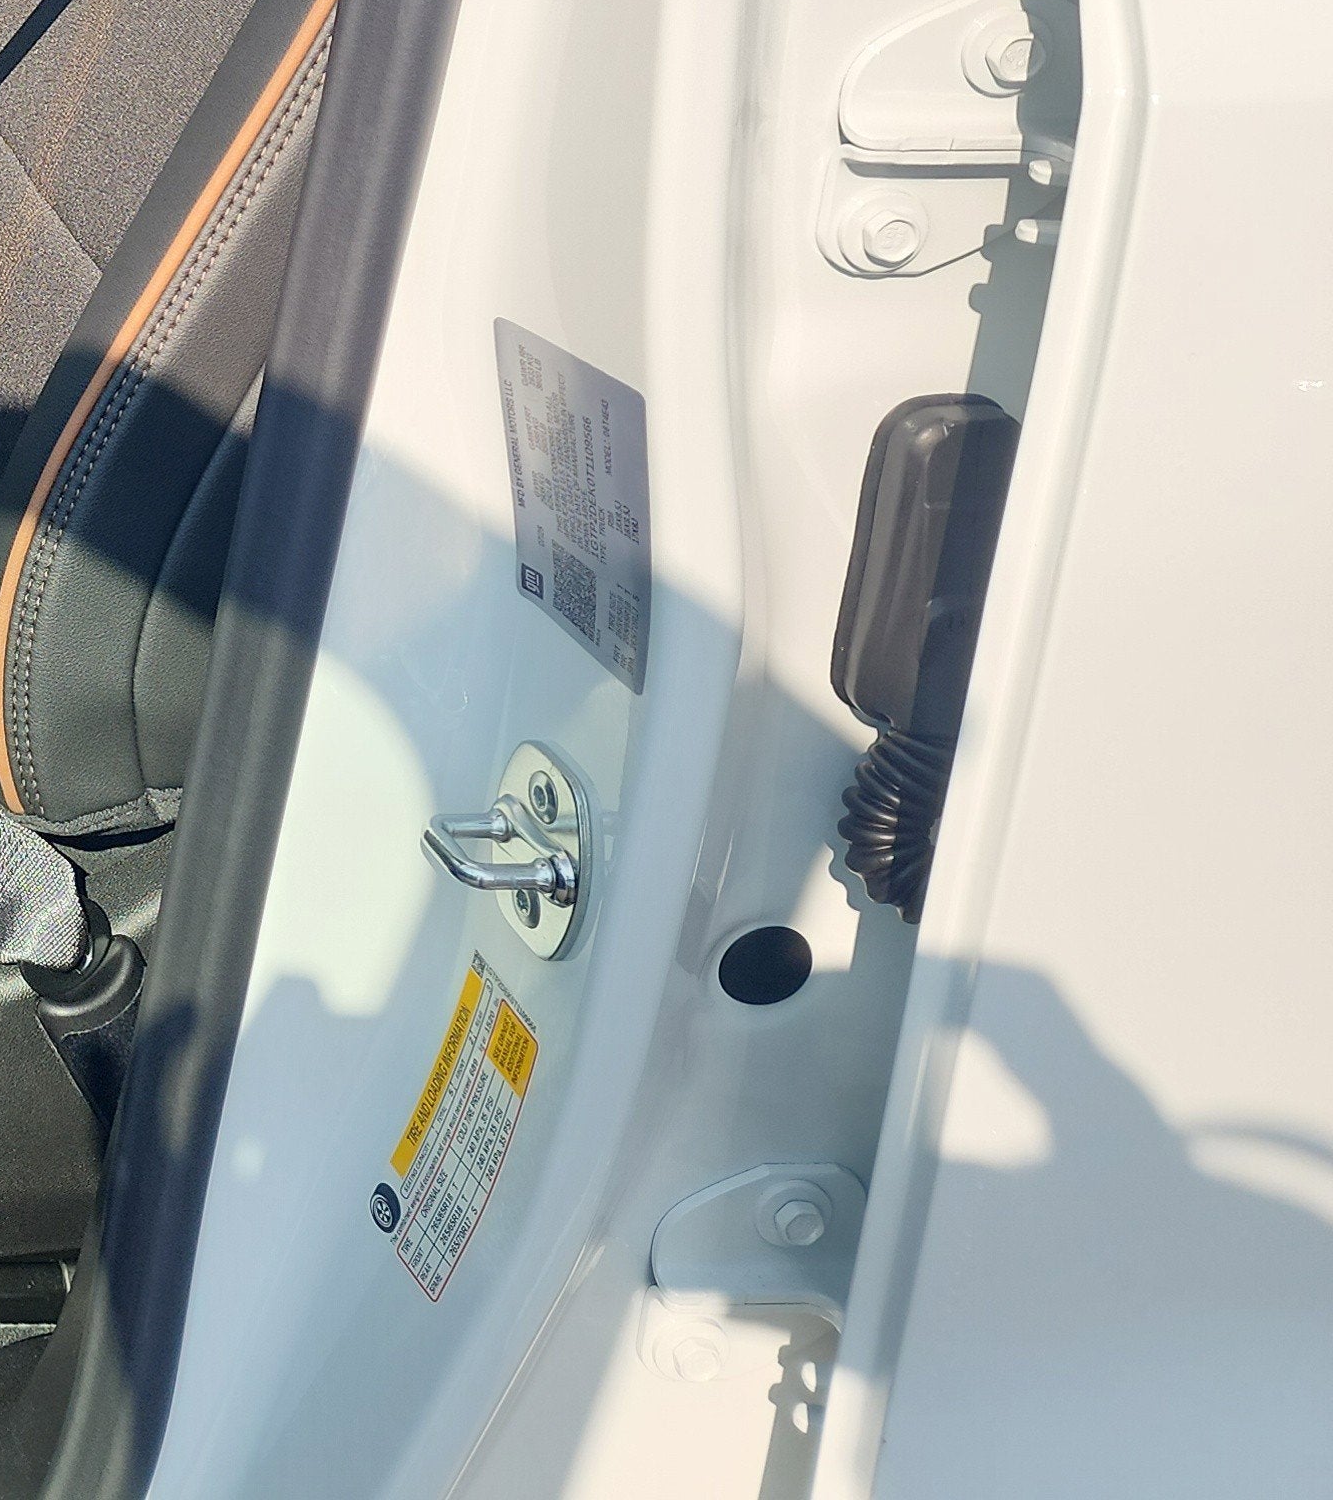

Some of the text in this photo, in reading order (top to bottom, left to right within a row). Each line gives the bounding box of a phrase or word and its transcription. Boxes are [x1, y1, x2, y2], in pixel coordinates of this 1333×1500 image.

[502, 377, 526, 511] MFD BY GENERAL MOTORS LLC
[406, 1001, 471, 1146] TIRE AND LOADING INFORMATION
[492, 1043, 501, 1061] SEE
[497, 1020, 517, 1068] MANUAL FOR
[504, 1030, 523, 1073] ADDITIONAL
[510, 1035, 530, 1085] INFORMATION
[400, 1067, 489, 1255] TIRE ORIGINAL SIZE COLD TIRE PRESSURE
[409, 1187, 422, 1208] weight
[422, 1154, 439, 1186] occupants
[440, 1126, 452, 1148] cargo
[410, 1246, 425, 1270] FRONT
[466, 1139, 477, 1159] 240
[479, 1110, 489, 1125] 35
[484, 1094, 495, 1113] PSI
[419, 1261, 432, 1282] REAR
[475, 1151, 487, 1171] 240
[488, 1121, 498, 1137] 35
[493, 1105, 504, 1125] PSI
[428, 1272, 443, 1294] SPARE
[484, 1162, 496, 1183] 240
[497, 1133, 507, 1148] 35
[502, 1117, 513, 1136] PSI
